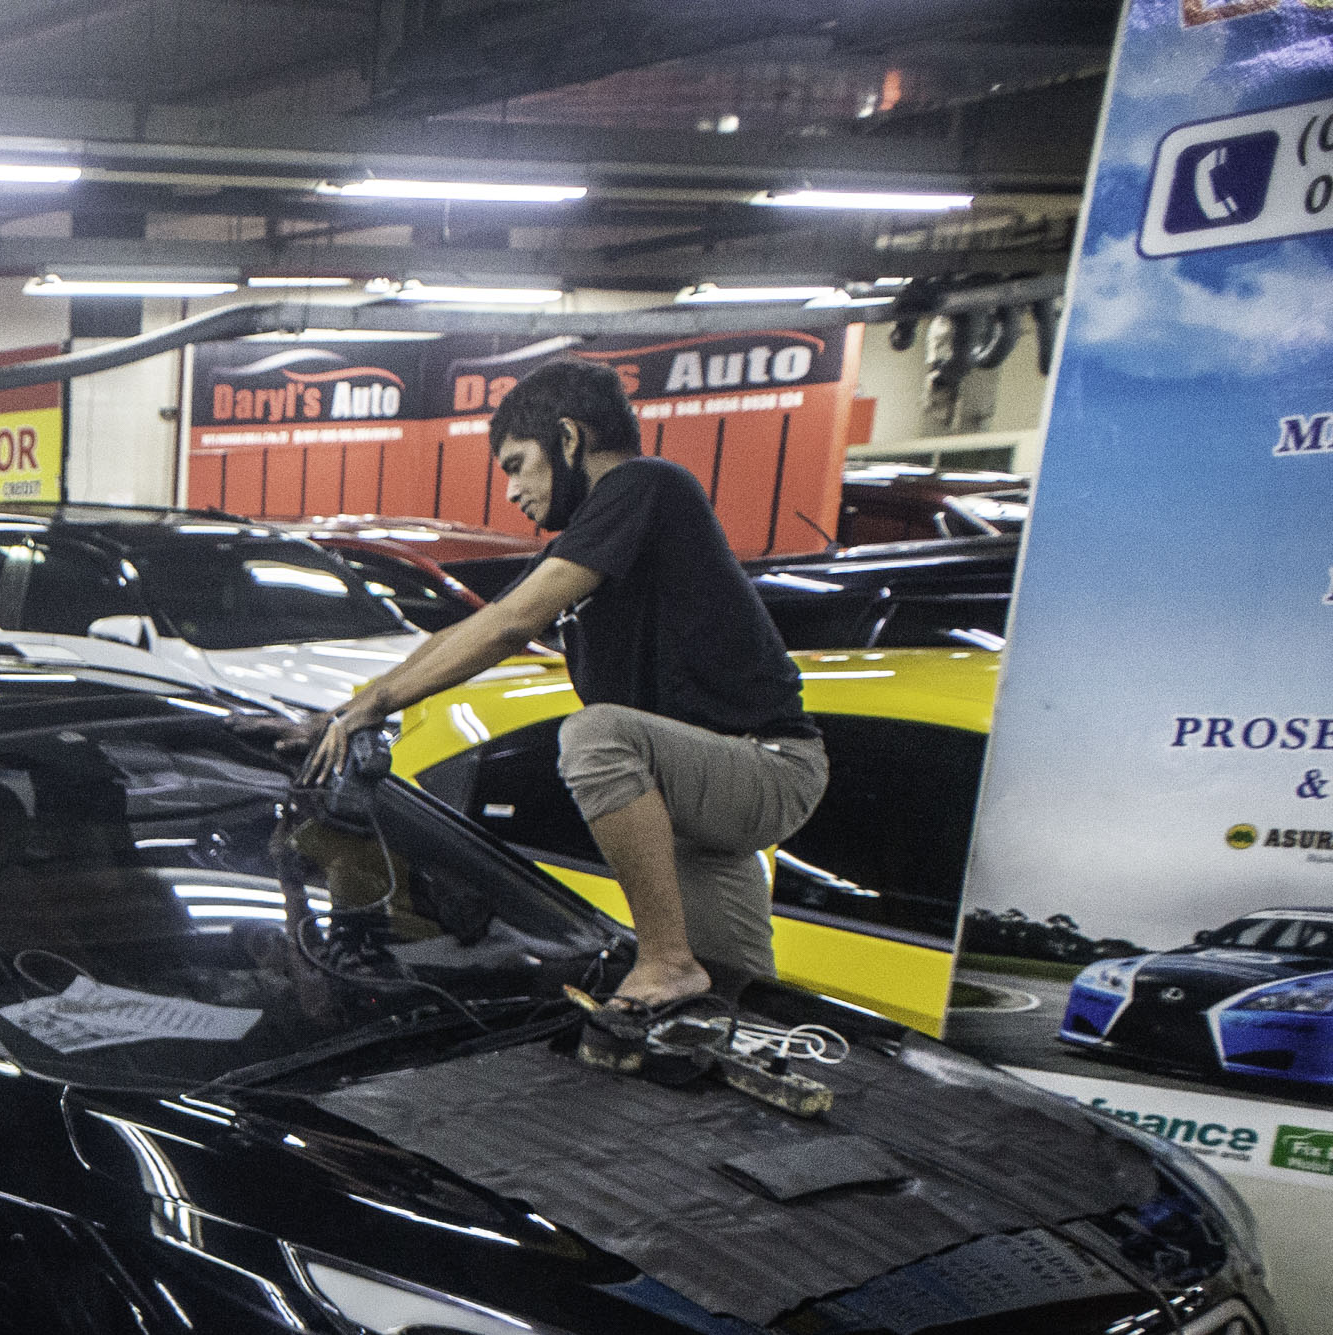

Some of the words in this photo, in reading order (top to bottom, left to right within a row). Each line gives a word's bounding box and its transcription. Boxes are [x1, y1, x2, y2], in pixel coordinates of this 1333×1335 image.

[665, 346, 813, 392] Auto
[214, 382, 322, 422] Daryl's
[330, 380, 401, 418] Auto
[1296, 768, 1329, 799] &
